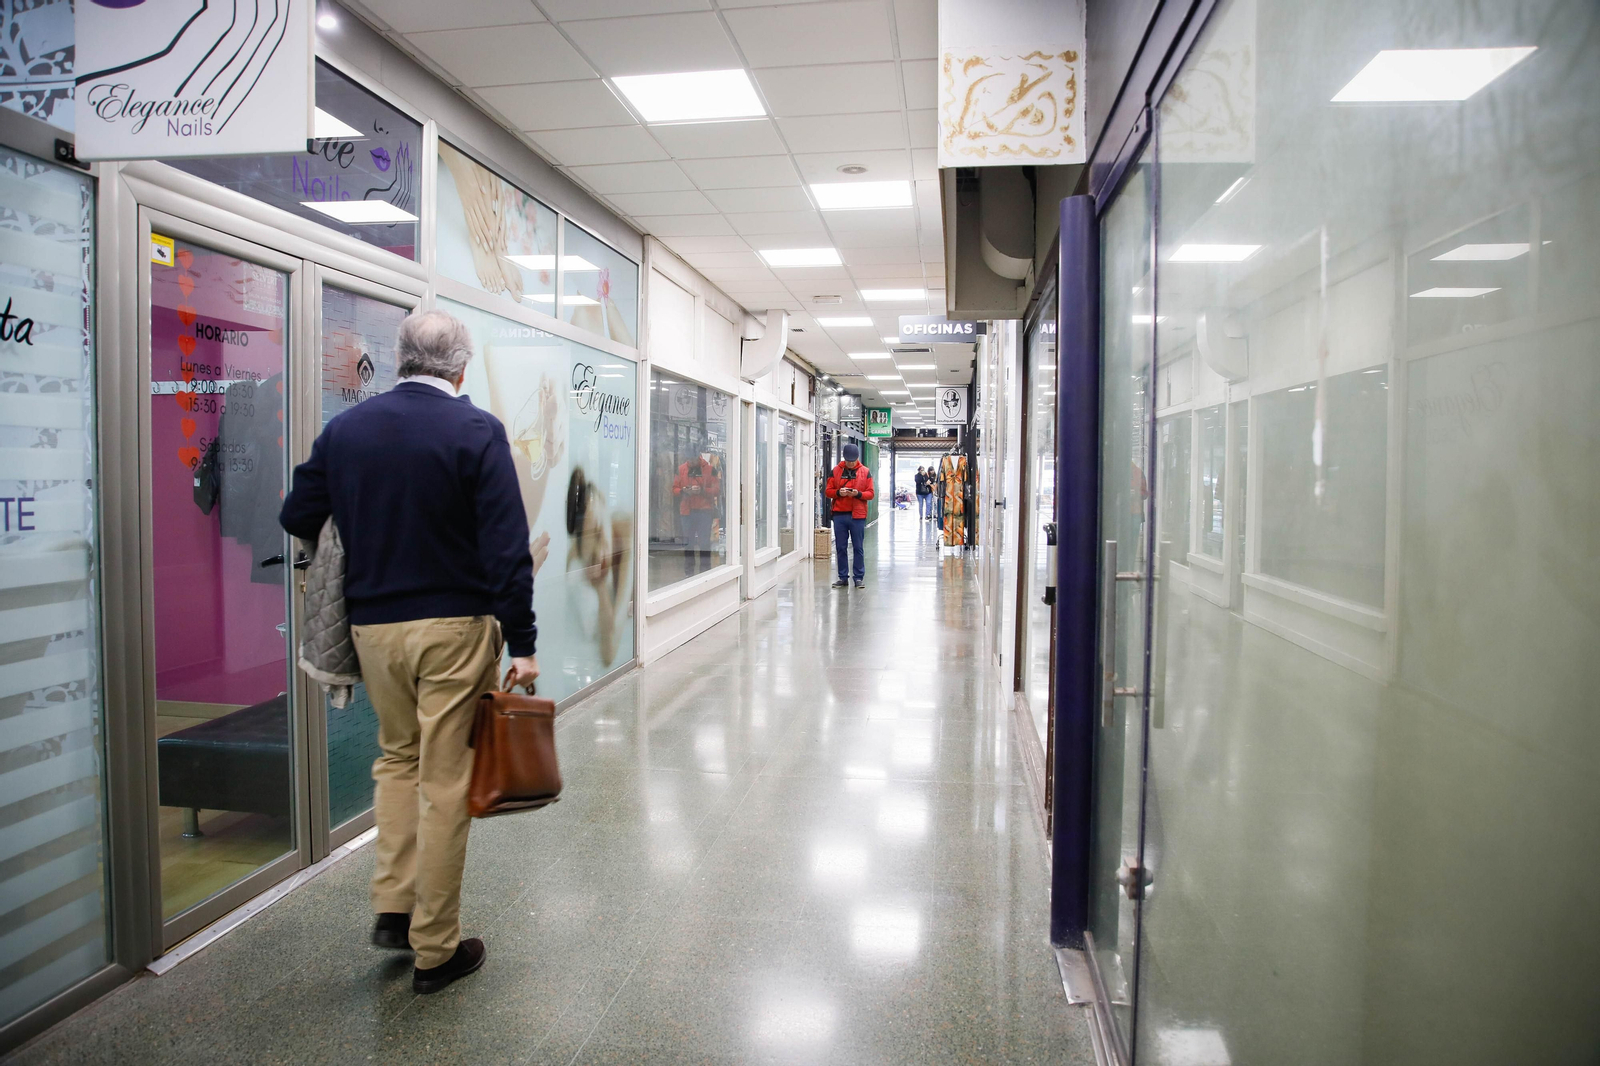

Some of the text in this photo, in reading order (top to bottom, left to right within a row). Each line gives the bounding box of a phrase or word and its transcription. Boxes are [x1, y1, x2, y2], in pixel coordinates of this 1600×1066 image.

[87, 83, 216, 135] Elegance
[167, 117, 213, 137] Nails
[195, 322, 249, 347] HORARIO
[902, 323, 973, 335] OFICINAS
[180, 356, 262, 382] Lunes a Viernes
[190, 378, 254, 399] 9:00 a 13:30
[341, 387, 380, 404] MAGN
[571, 362, 631, 433] Elegance
[188, 397, 255, 418] 15:30 a 19:30
[603, 415, 631, 448] Beauty
[199, 437, 247, 454] Sábados
[218, 462, 225, 472] a
[228, 457, 254, 472] 13:30
